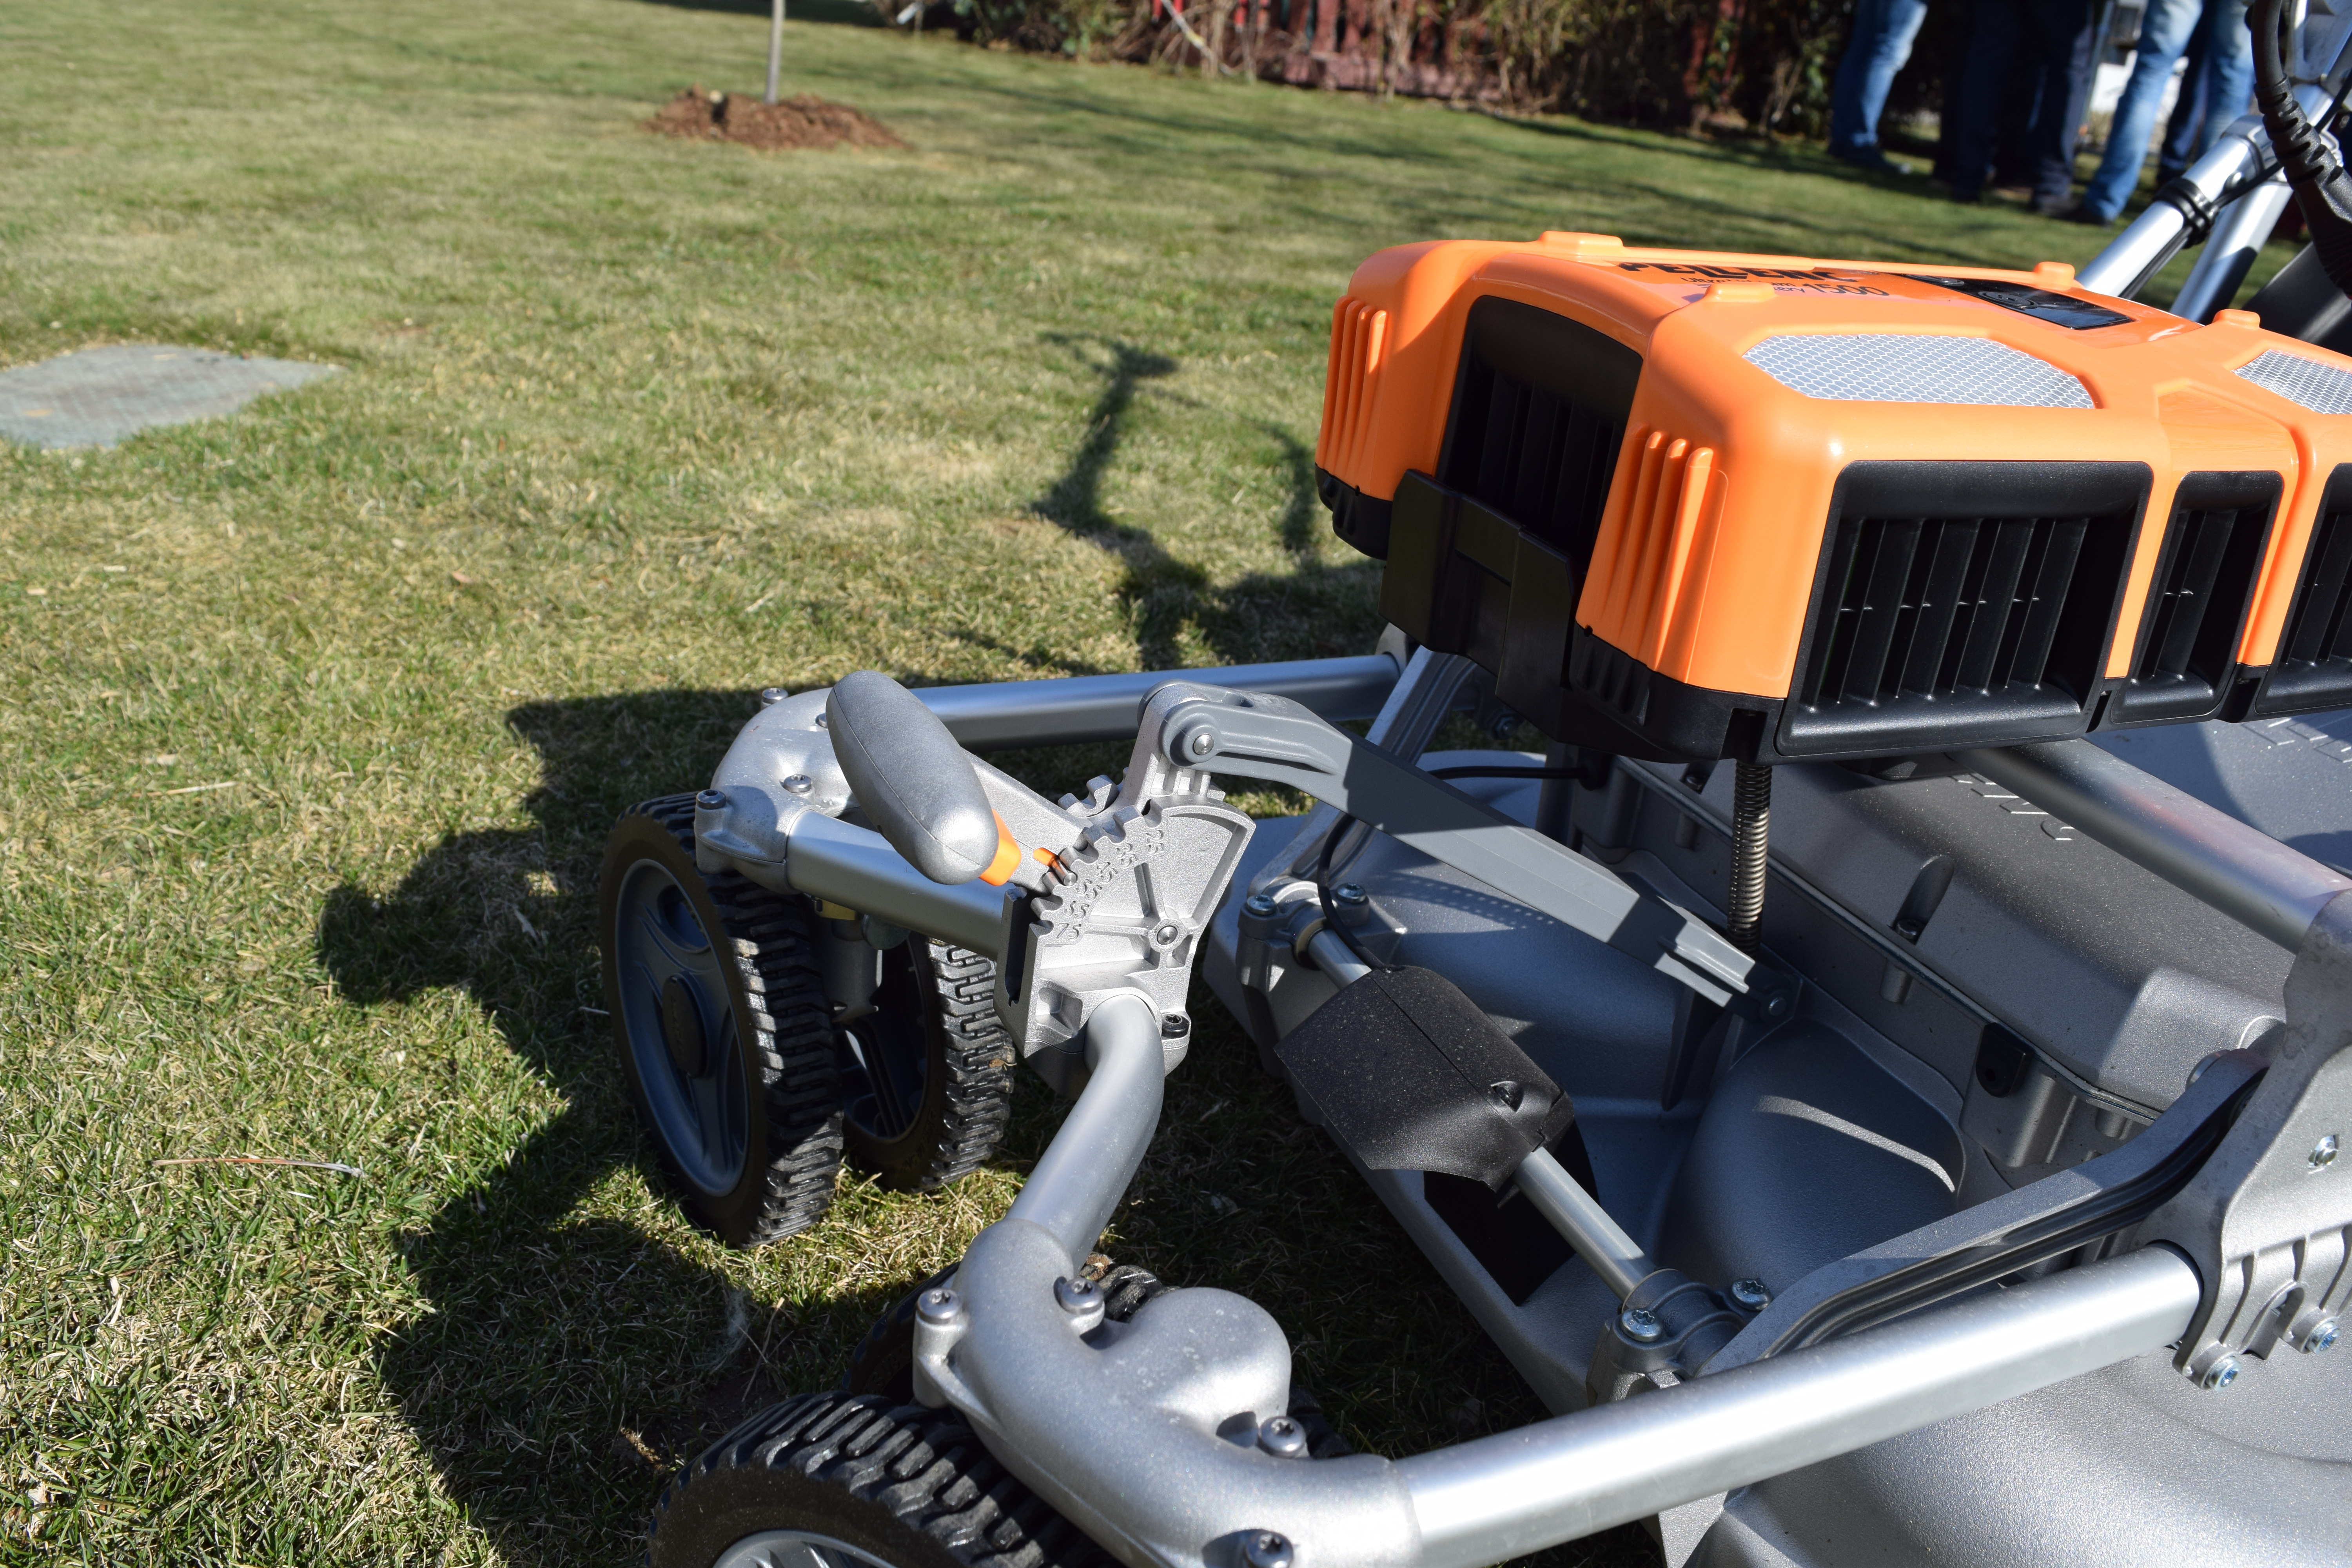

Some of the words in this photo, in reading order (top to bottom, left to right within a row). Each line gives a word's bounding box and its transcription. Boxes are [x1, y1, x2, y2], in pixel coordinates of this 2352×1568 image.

[1617, 262, 1859, 283] PELLENC
[1802, 283, 1890, 296] 1500
[1145, 829, 1165, 856] 25
[1116, 842, 1138, 868] 35
[1094, 861, 1118, 883] 45
[1076, 878, 1103, 901] 55
[1064, 900, 1090, 921] 65
[1056, 922, 1082, 941] 75
